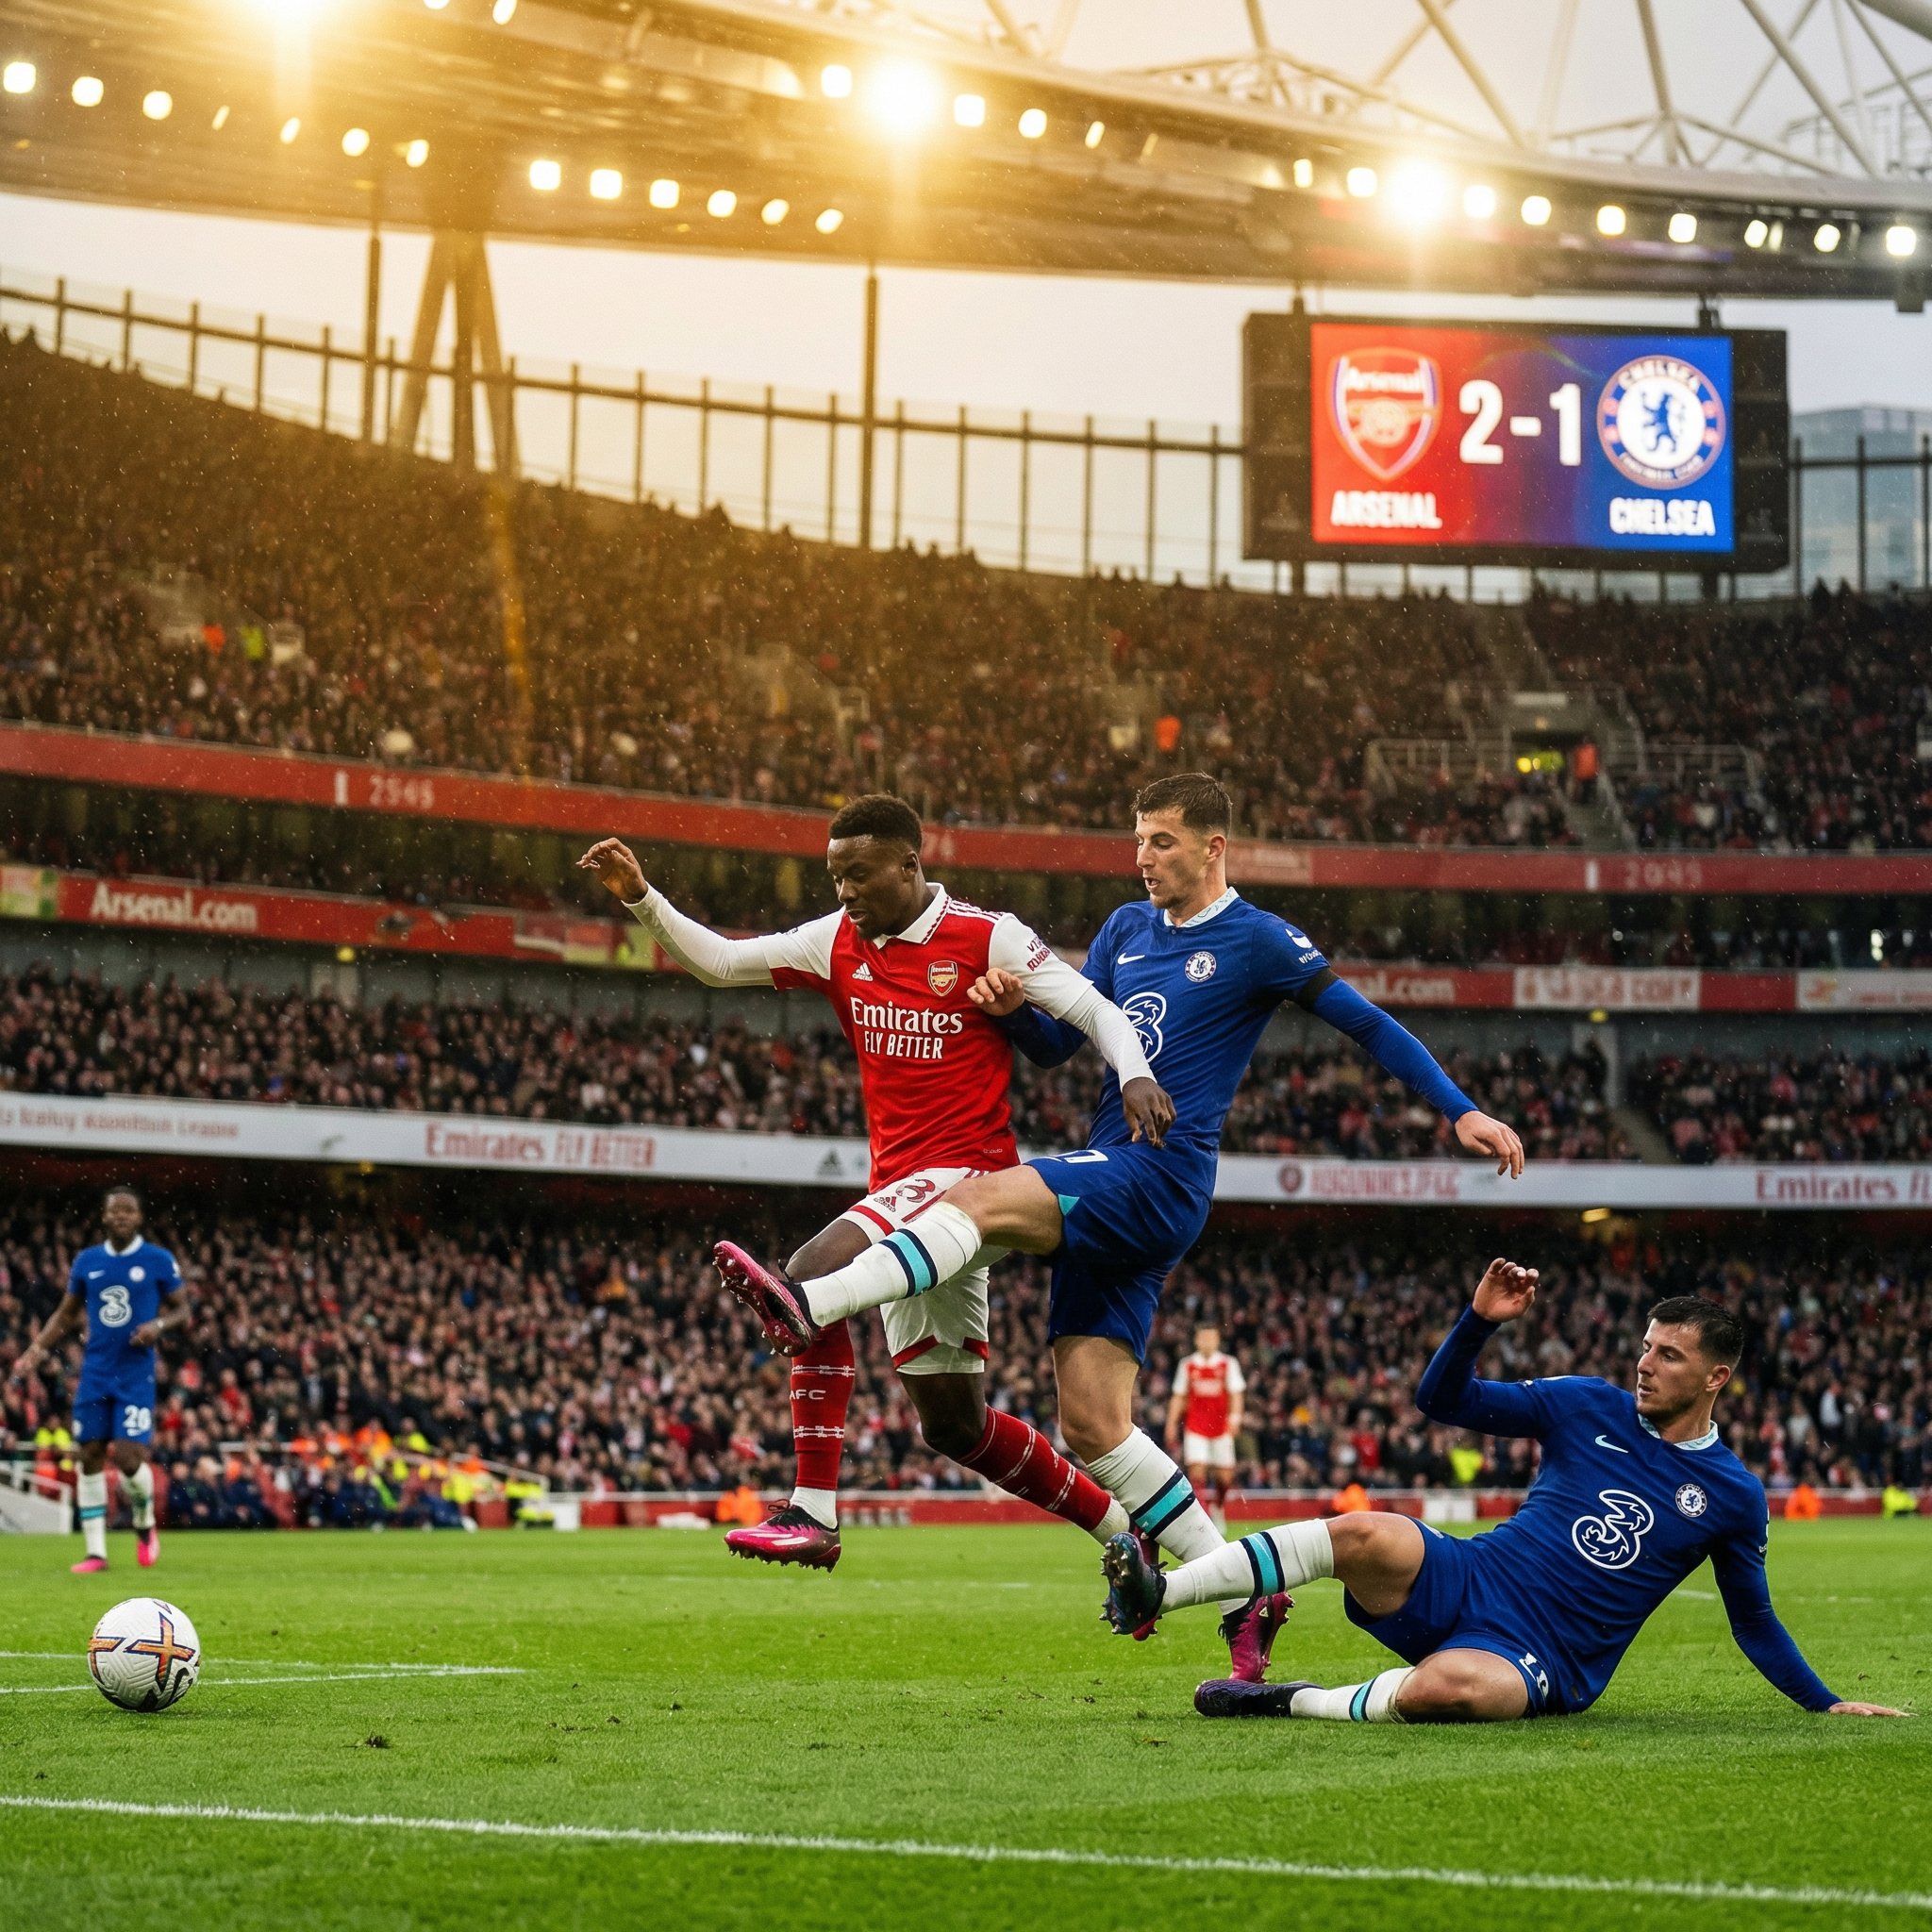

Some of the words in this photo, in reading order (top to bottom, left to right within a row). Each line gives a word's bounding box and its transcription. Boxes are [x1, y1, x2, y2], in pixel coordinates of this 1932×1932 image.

[1330, 490, 1443, 529] ARSENAL
[1608, 497, 1716, 537] CHELSEA
[90, 881, 258, 933] Arsenal.com
[850, 996, 963, 1034] Emirates
[864, 1030, 884, 1055] FLY
[886, 1033, 943, 1059] BETTER
[1756, 1168, 1898, 1201] Emirates
[790, 1389, 826, 1401] AFC
